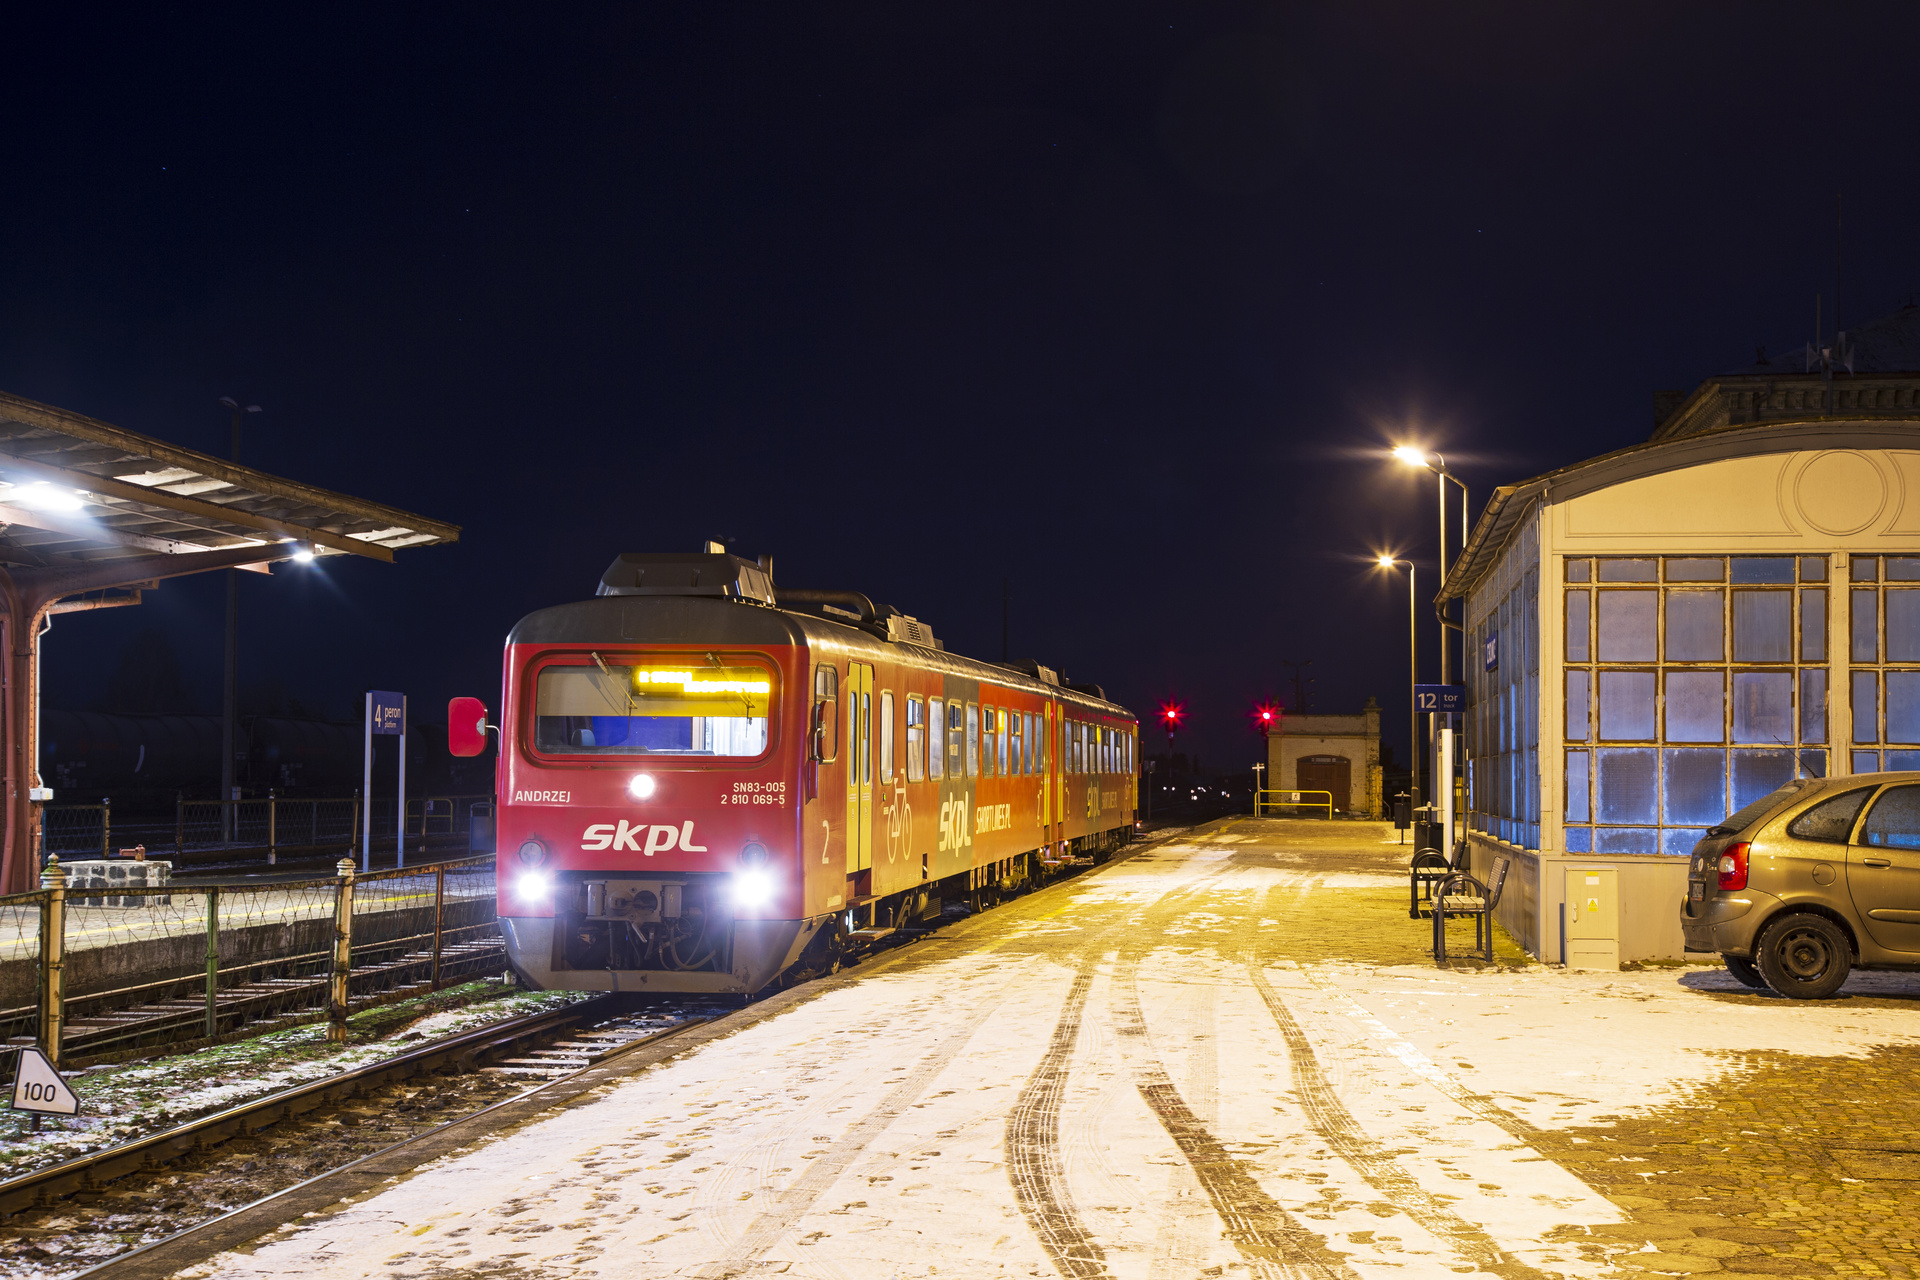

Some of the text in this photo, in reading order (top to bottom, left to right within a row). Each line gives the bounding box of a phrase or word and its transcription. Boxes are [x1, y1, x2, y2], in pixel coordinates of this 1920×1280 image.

[1418, 693, 1458, 709] 12 tor
[375, 704, 401, 727] 4 peron
[733, 782, 786, 793] SN83-005
[515, 790, 571, 803] ANDRZEJ
[720, 794, 786, 805] 2 810 069-5
[821, 819, 830, 865] 2
[24, 1082, 56, 1102] 100
